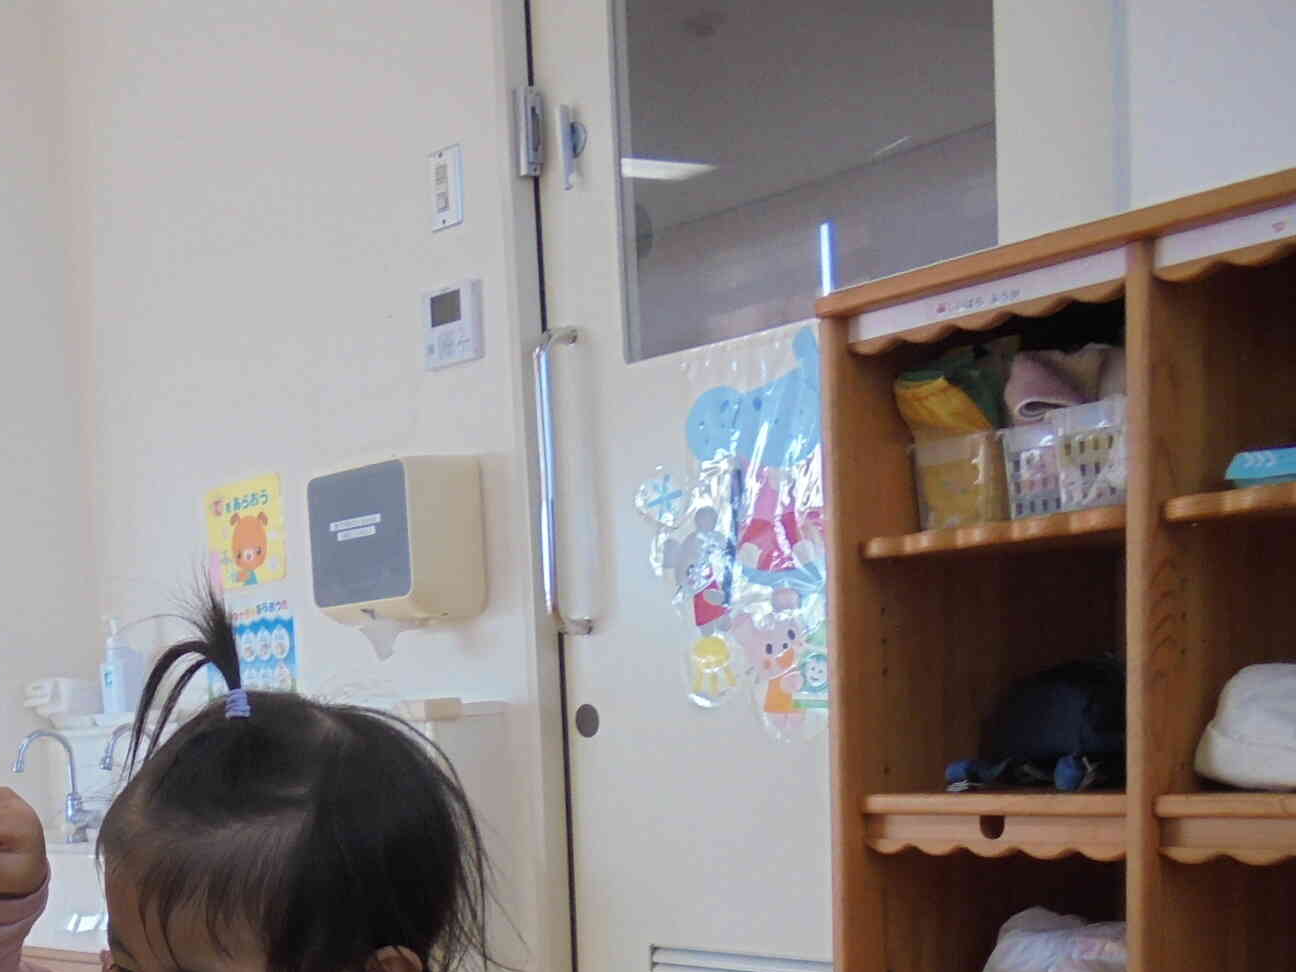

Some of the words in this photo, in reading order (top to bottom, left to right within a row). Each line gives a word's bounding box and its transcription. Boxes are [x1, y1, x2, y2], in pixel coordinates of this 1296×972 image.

[212, 490, 270, 516] てをあらおう
